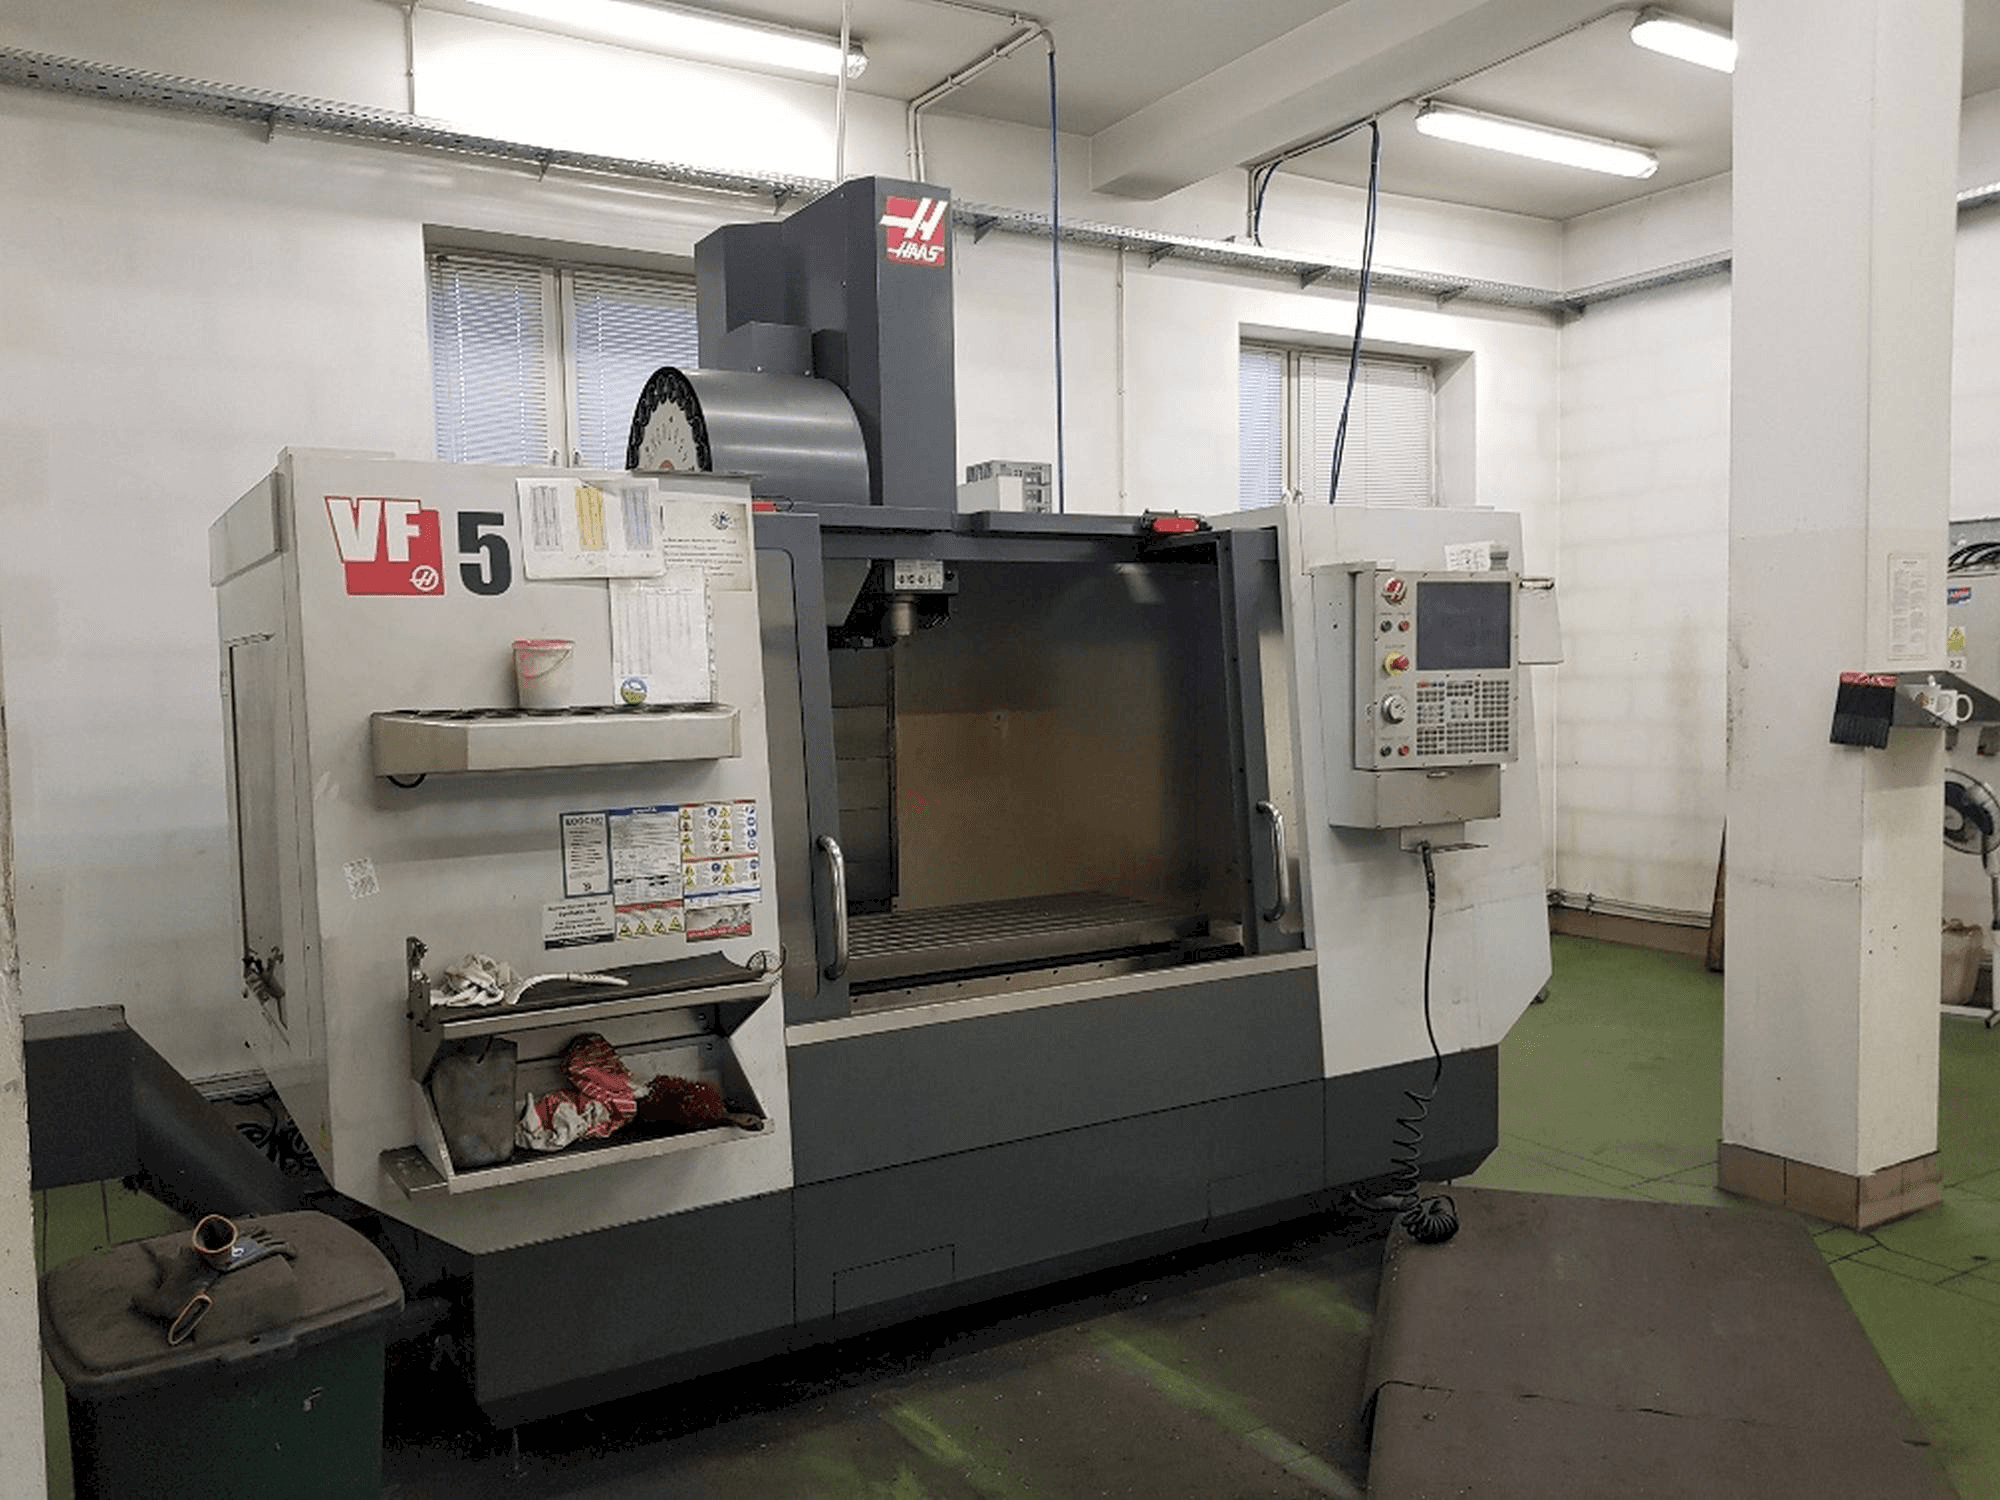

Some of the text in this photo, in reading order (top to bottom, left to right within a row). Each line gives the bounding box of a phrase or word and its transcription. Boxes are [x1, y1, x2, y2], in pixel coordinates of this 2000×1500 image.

[887, 241, 945, 262] HAAS
[325, 496, 421, 563] VF
[457, 511, 512, 595] 5
